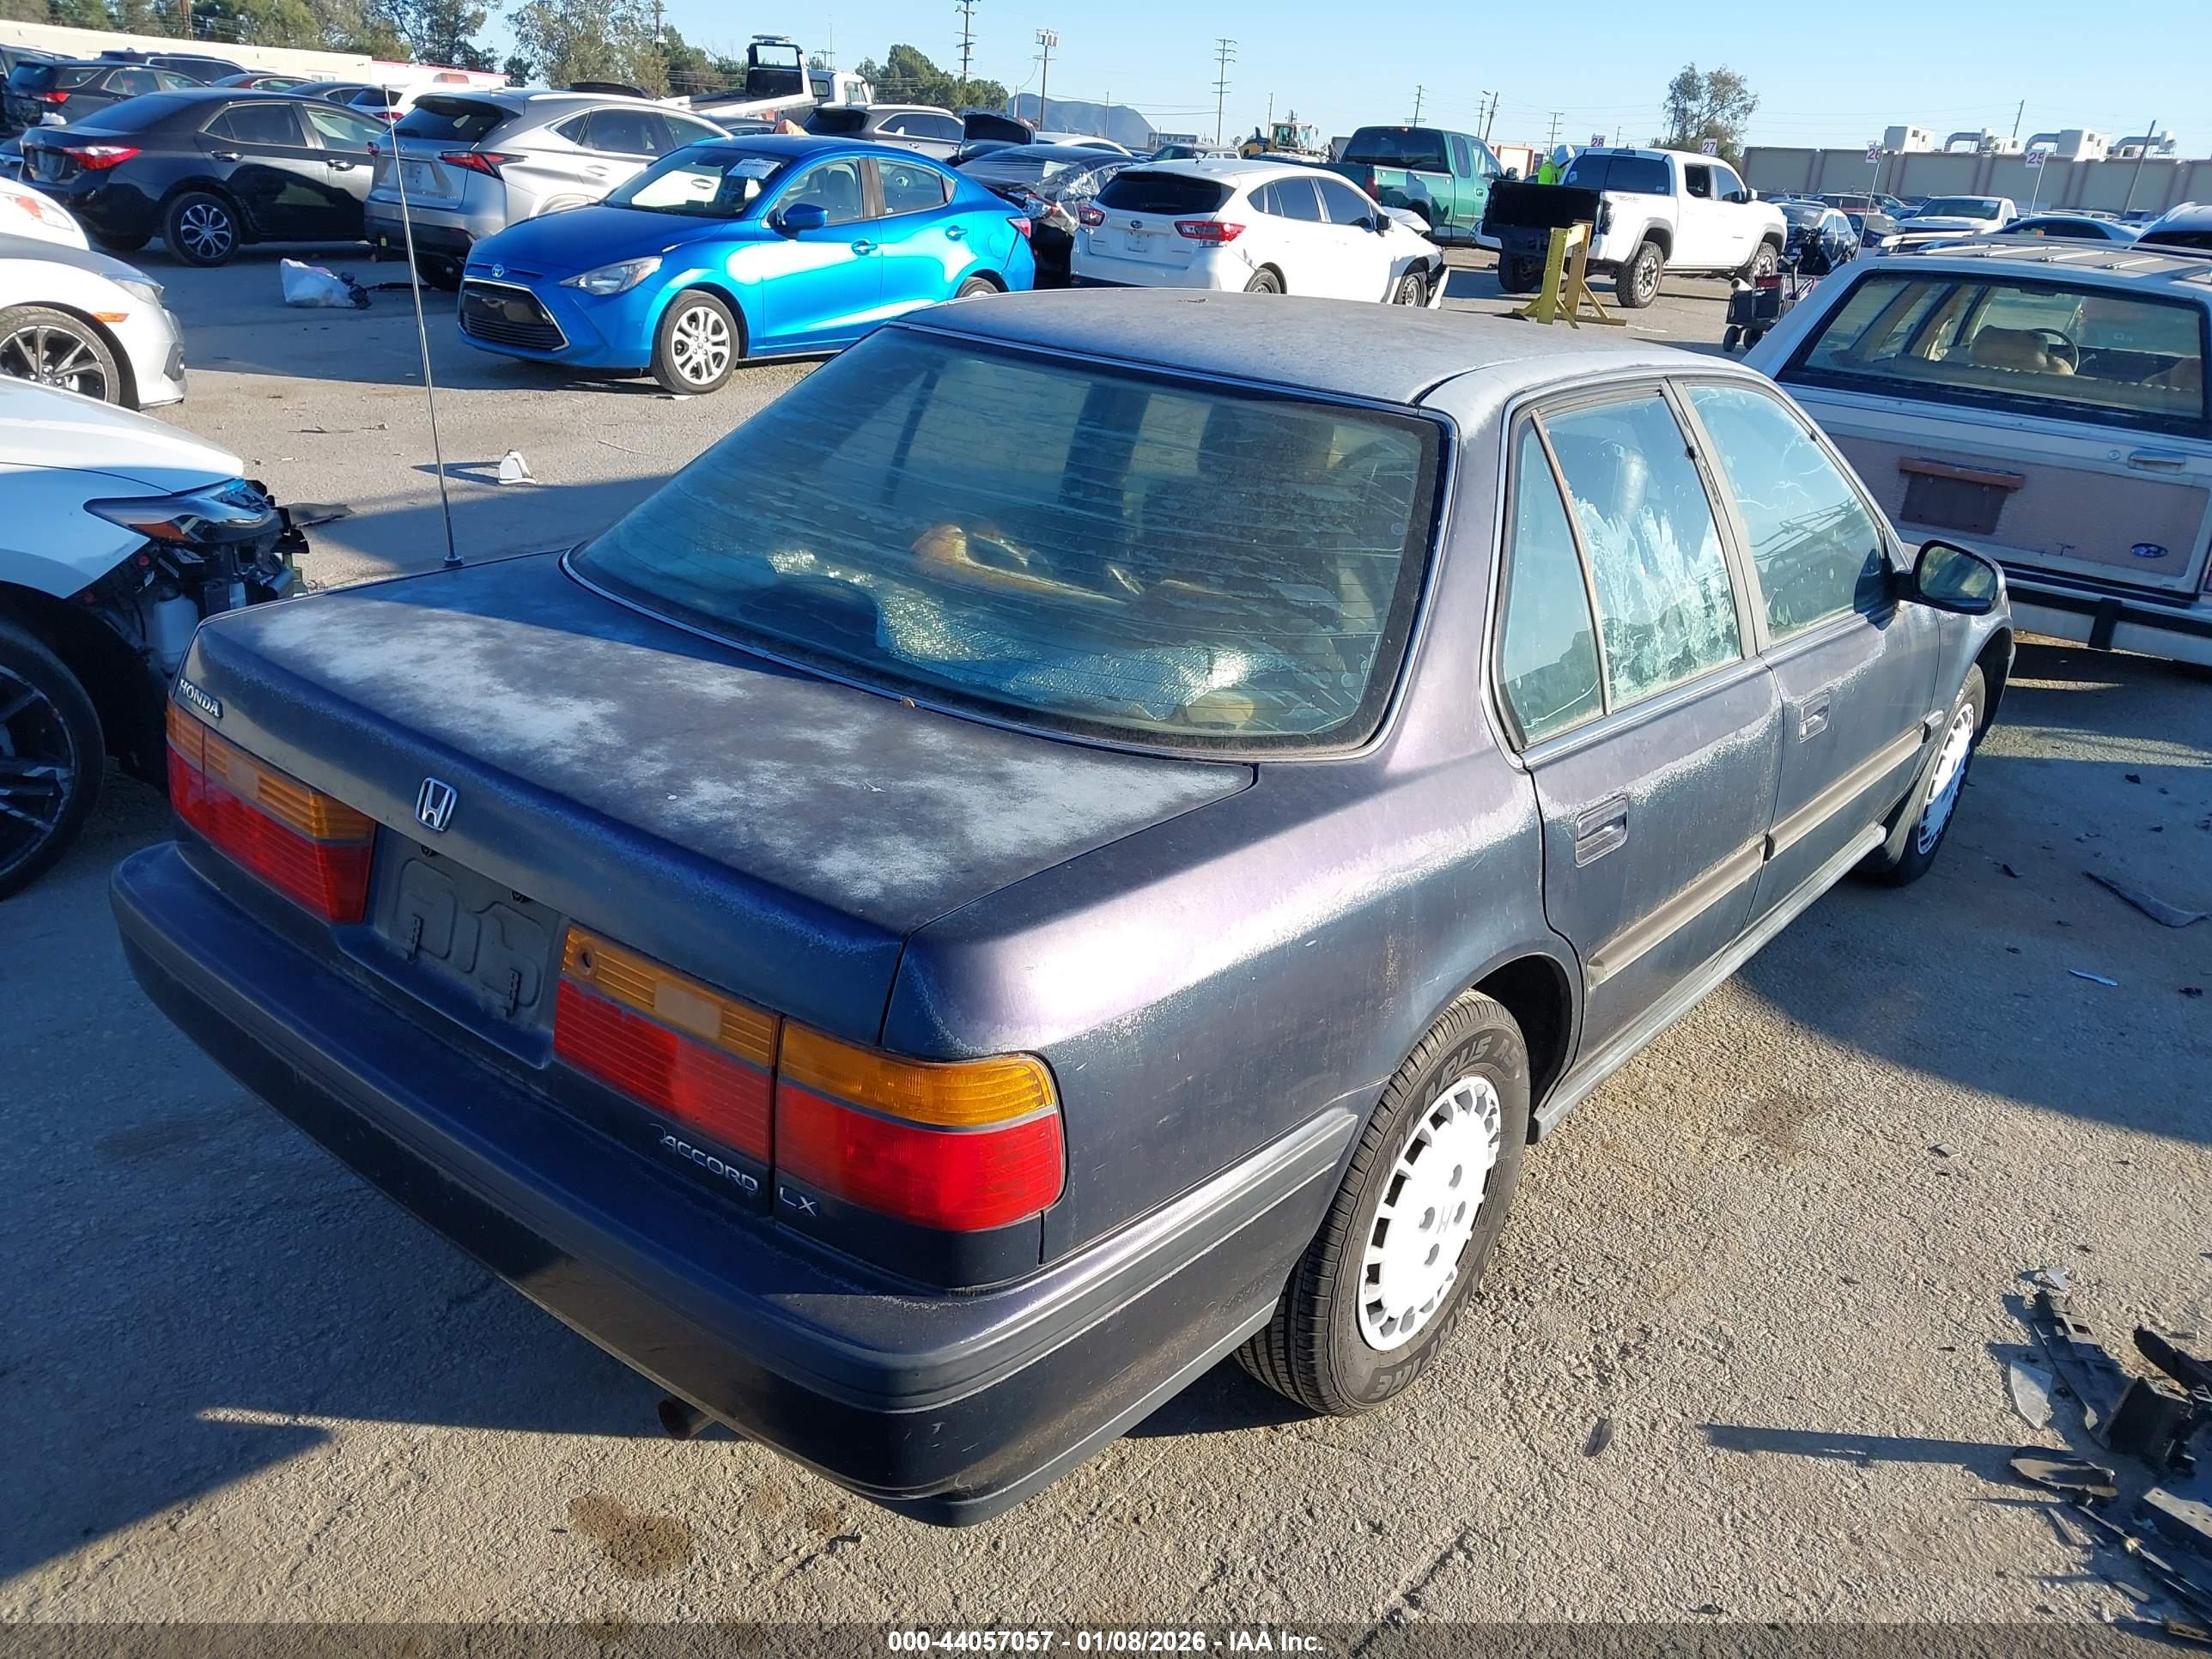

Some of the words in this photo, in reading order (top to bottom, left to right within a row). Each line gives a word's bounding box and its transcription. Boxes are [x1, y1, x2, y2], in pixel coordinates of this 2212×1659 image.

[1591, 137, 1605, 147] 28
[1703, 142, 1717, 154] 27
[2027, 152, 2044, 164] 25
[178, 678, 221, 718] HONDA
[658, 1133, 759, 1194] ACCORD
[779, 1185, 817, 1218] LX
